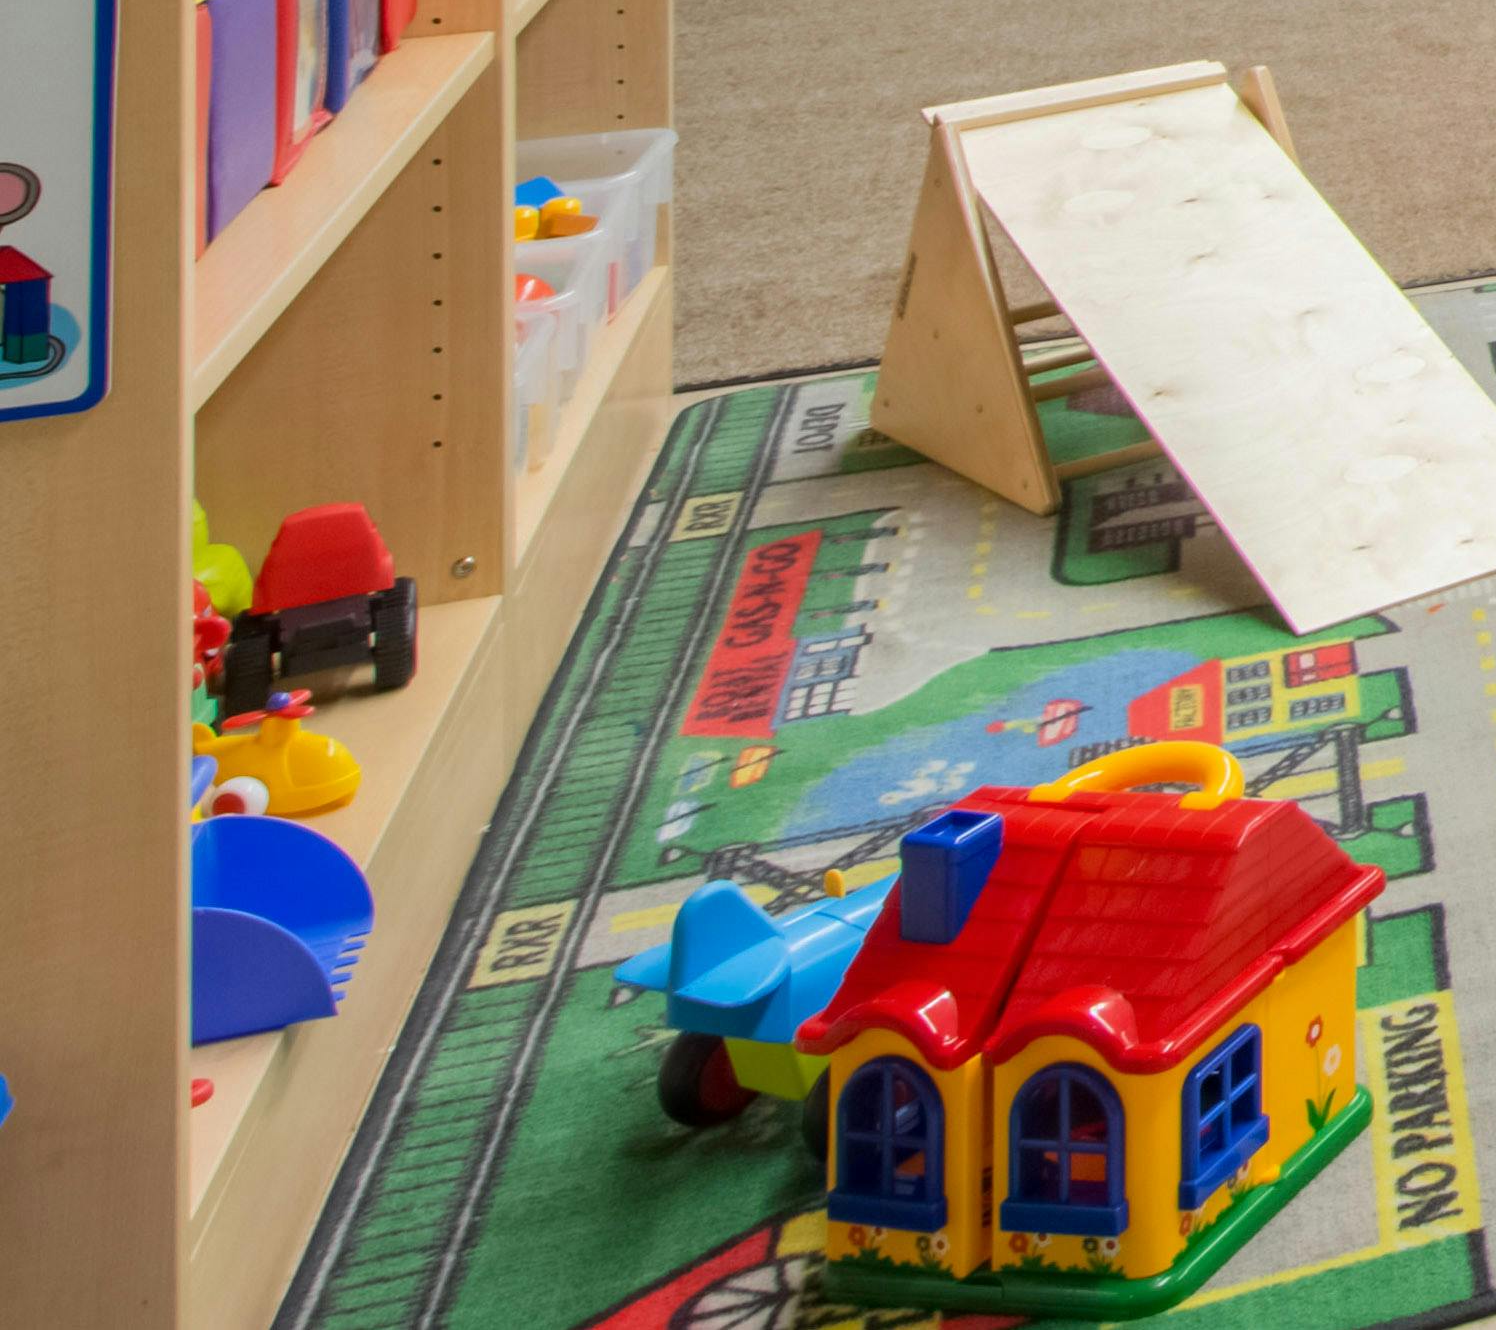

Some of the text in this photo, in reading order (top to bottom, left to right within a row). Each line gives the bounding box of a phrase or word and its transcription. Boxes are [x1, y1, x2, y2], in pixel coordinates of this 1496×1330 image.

[793, 402, 846, 454] DEPOT
[683, 498, 737, 532] RXR
[489, 912, 565, 973] RXR
[1379, 1002, 1463, 1231] NO PARKING
